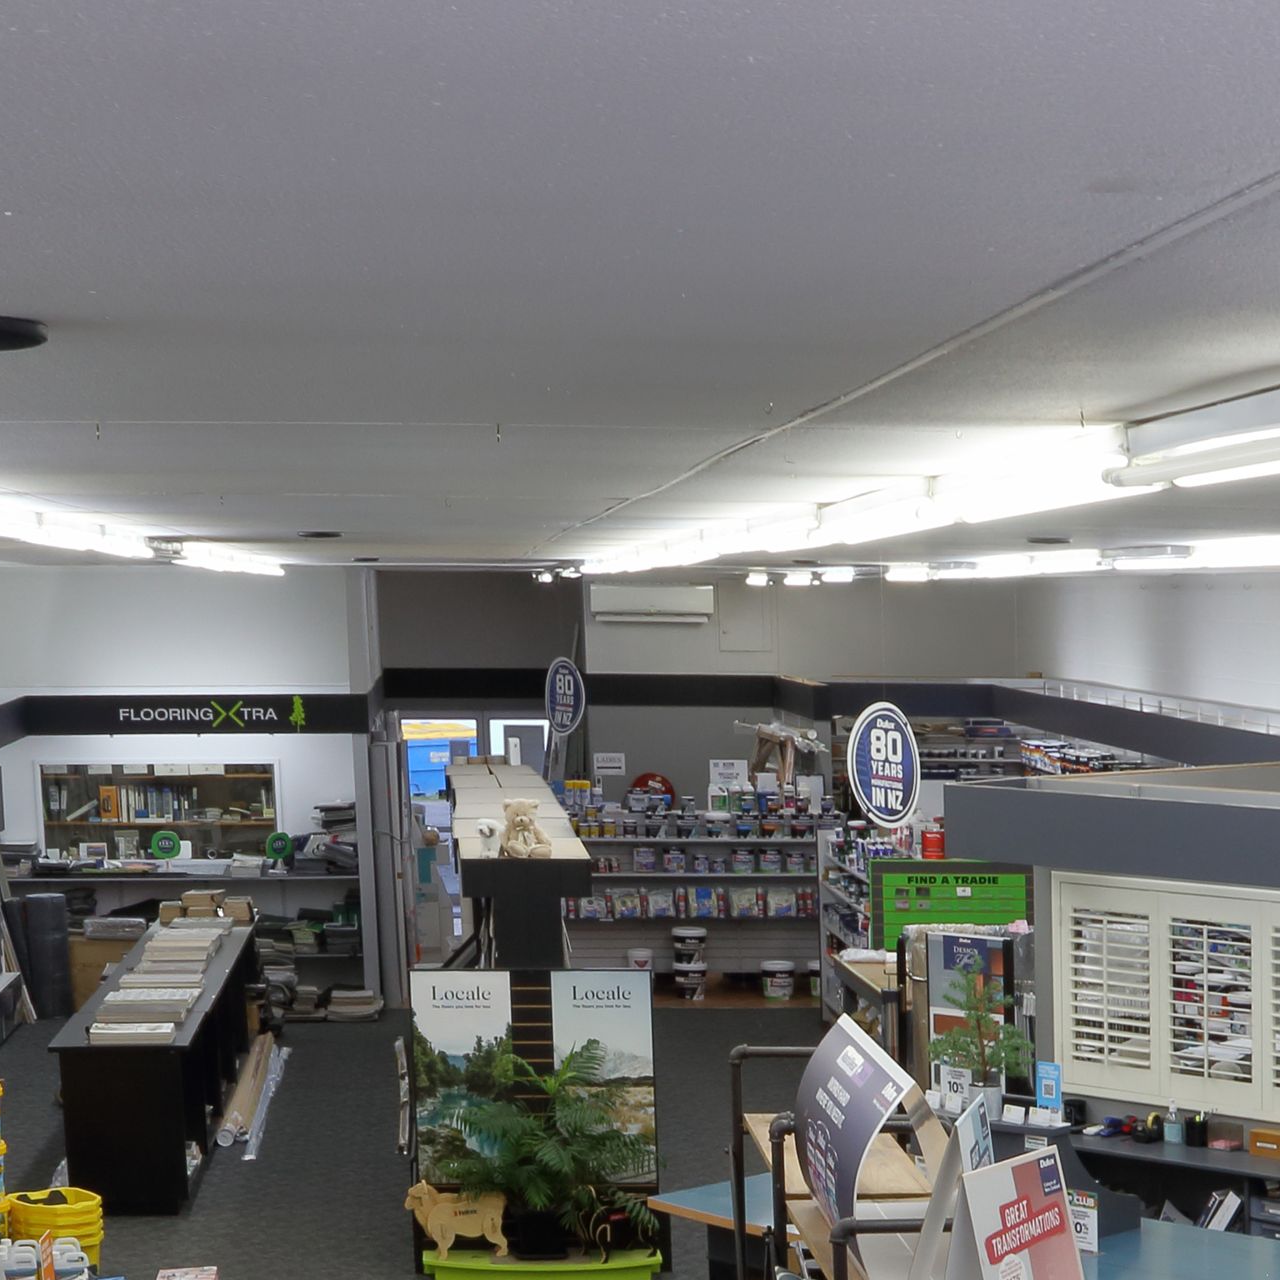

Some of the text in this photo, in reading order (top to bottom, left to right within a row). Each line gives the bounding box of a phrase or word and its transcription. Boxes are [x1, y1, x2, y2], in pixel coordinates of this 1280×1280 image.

[556, 675, 574, 695] 80
[556, 694, 574, 704] YEARS
[876, 719, 895, 729] Dulux
[870, 728, 902, 763] 80
[871, 760, 903, 779] YEARS
[871, 787, 903, 811] IN NZ
[907, 876, 999, 885] FIND A TRADIE
[431, 985, 491, 1000] Locale
[572, 985, 632, 1000] Locale
[947, 1081, 964, 1093] 10%
[1039, 1158, 1055, 1168] Dulux
[1074, 1192, 1095, 1207] CLUB
[1005, 1200, 1029, 1227] GREAT
[992, 1207, 1061, 1257] TRANSFORMATIONS
[1074, 1221, 1088, 1234] 0%
